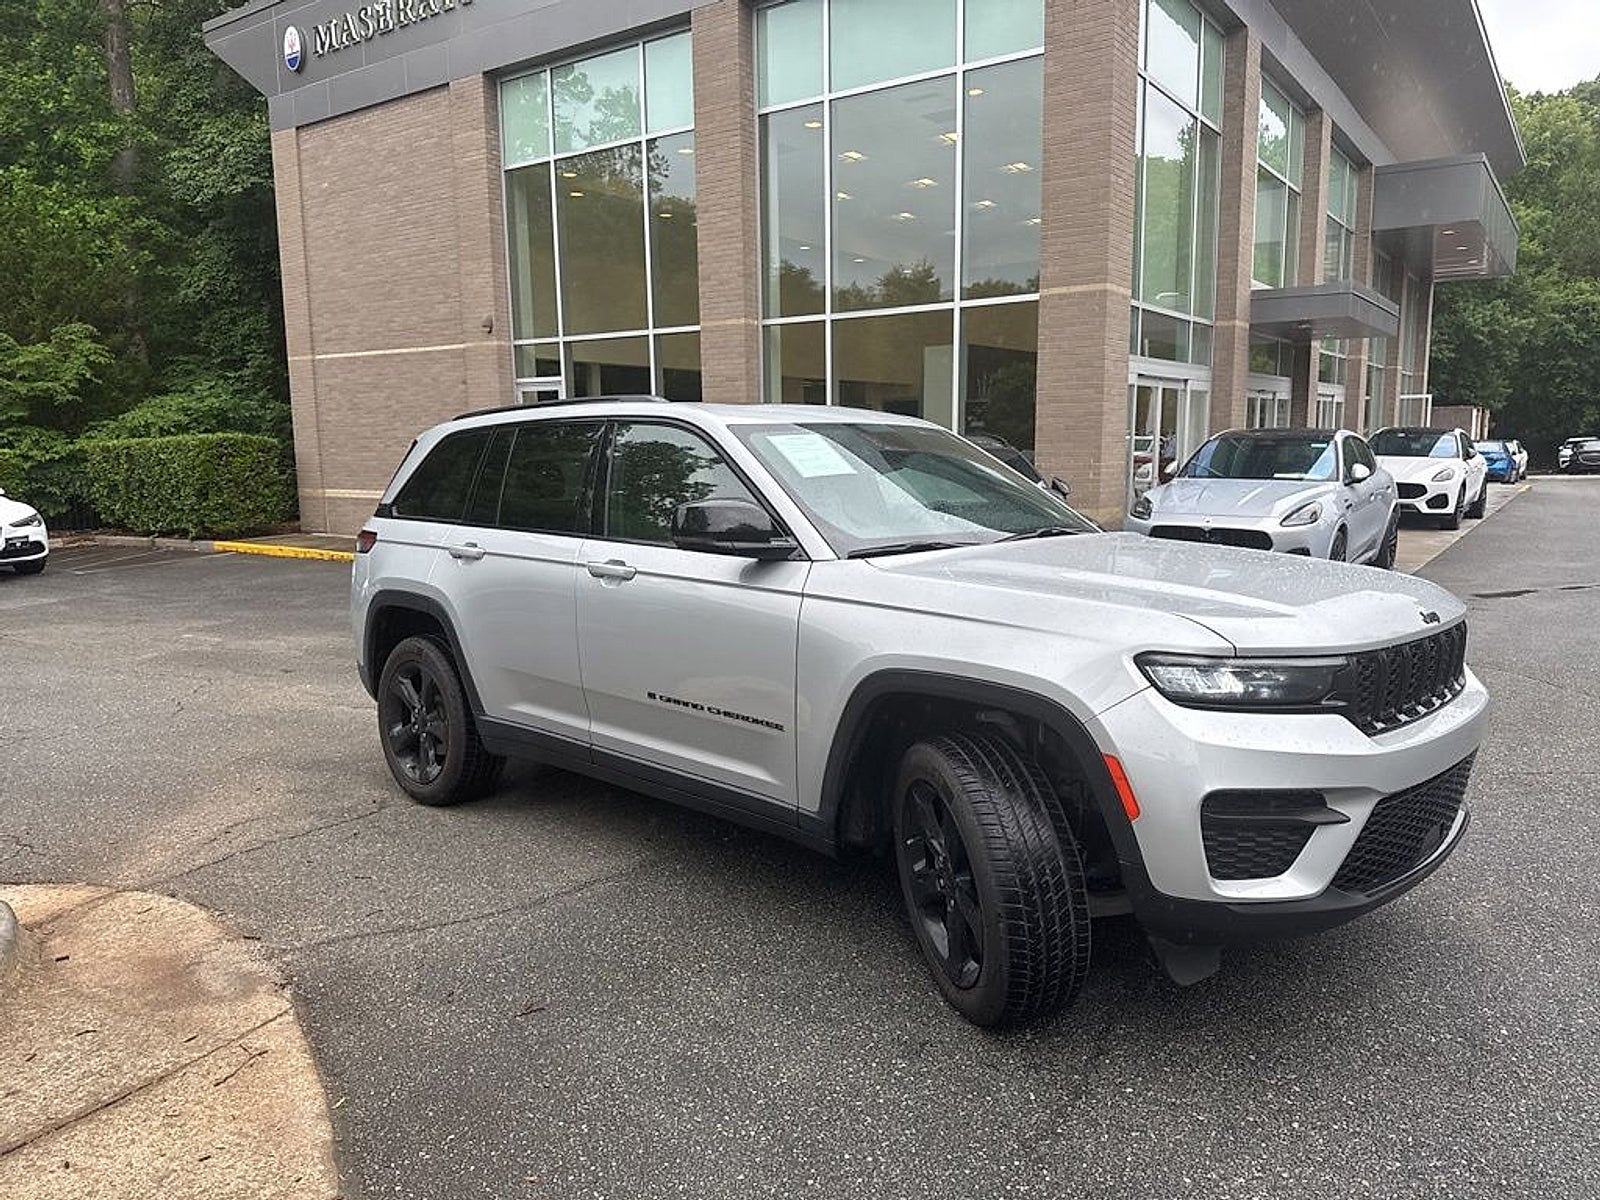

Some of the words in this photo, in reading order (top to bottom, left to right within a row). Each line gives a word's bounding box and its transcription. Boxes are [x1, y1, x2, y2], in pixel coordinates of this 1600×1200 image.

[313, 0, 472, 56] MASERA
[659, 695, 704, 711] GRAND
[707, 706, 785, 732] CHEROKEE
